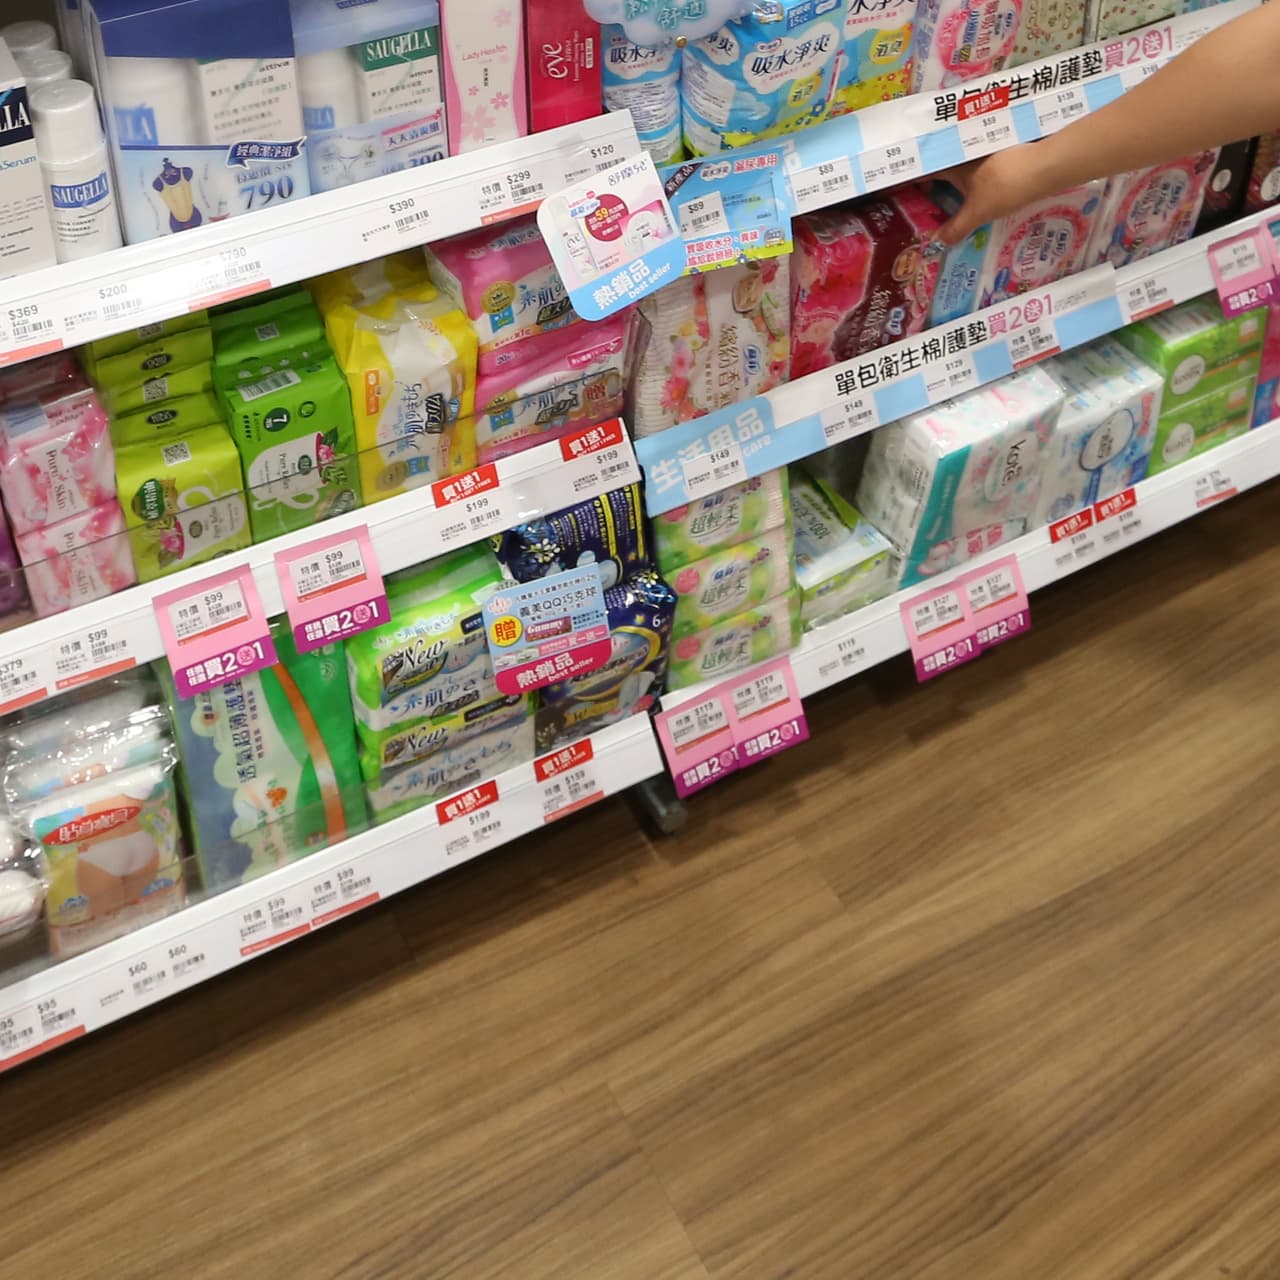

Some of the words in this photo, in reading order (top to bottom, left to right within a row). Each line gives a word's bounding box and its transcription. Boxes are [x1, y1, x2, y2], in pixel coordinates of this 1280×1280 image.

[591, 145, 614, 157] $120
[52, 172, 108, 206] SAUGELLA
[239, 175, 295, 210] 790
[389, 198, 415, 213] $390
[98, 283, 128, 299] $200
[8, 304, 39, 320] $369
[596, 450, 619, 465] $199
[711, 450, 729, 463] $149
[466, 497, 489, 512] $199
[168, 943, 187, 959] $60
[129, 961, 147, 976] $60
